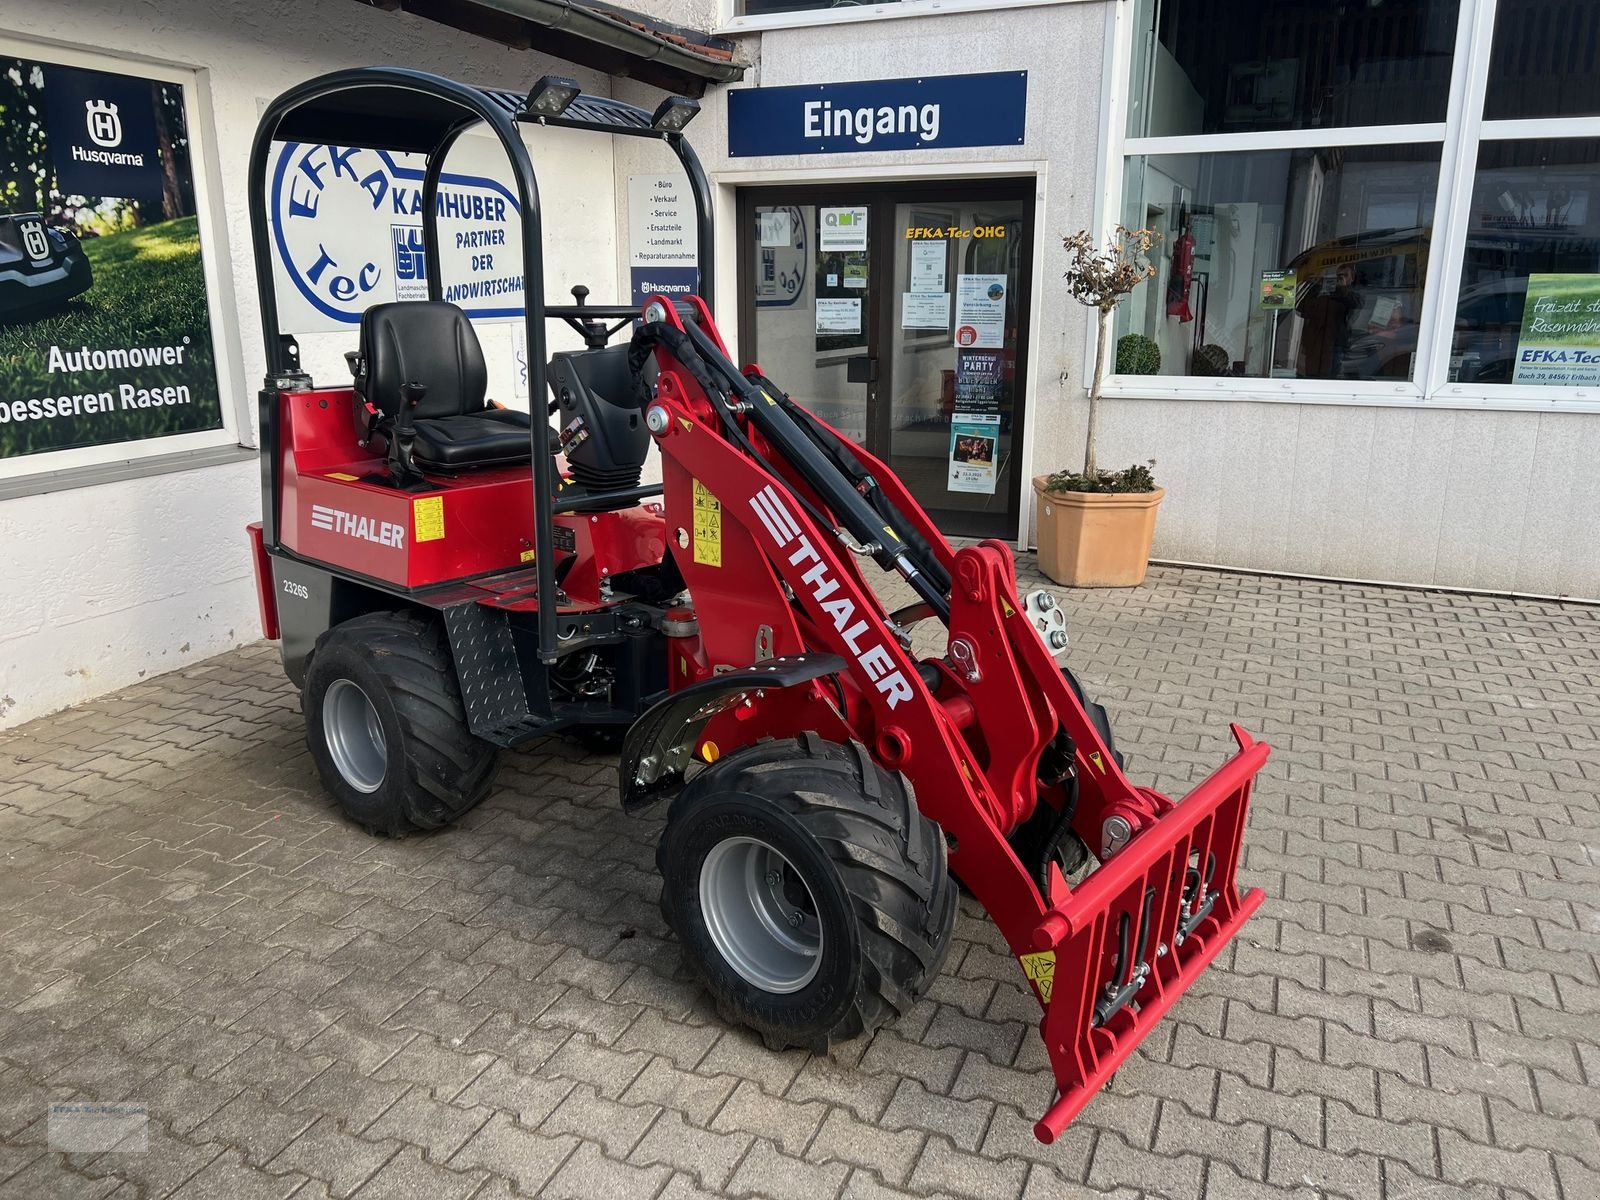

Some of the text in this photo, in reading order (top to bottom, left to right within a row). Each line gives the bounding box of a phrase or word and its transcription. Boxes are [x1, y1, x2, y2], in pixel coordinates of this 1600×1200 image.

[804, 100, 940, 144] Eingang
[72, 146, 144, 167] Husqvarna
[654, 195, 677, 203] Verkauf
[654, 209, 677, 217] Service
[455, 229, 505, 249] PARTNER
[905, 226, 1005, 239] EFKA-Tec OHG
[472, 254, 494, 271] DER
[639, 252, 695, 261] Reparaturannahme
[305, 243, 382, 301] Tec
[442, 276, 524, 303] ANDWIRTSCHA
[650, 283, 690, 293] Husqvarna
[1534, 296, 1582, 313] Freizeit
[1521, 350, 1600, 364] EFKA-Tec
[964, 362, 993, 371] PARTY
[119, 383, 191, 410] Rasen
[332, 510, 405, 550] THALER
[283, 579, 309, 600] 2326S
[787, 533, 915, 711] THALER
